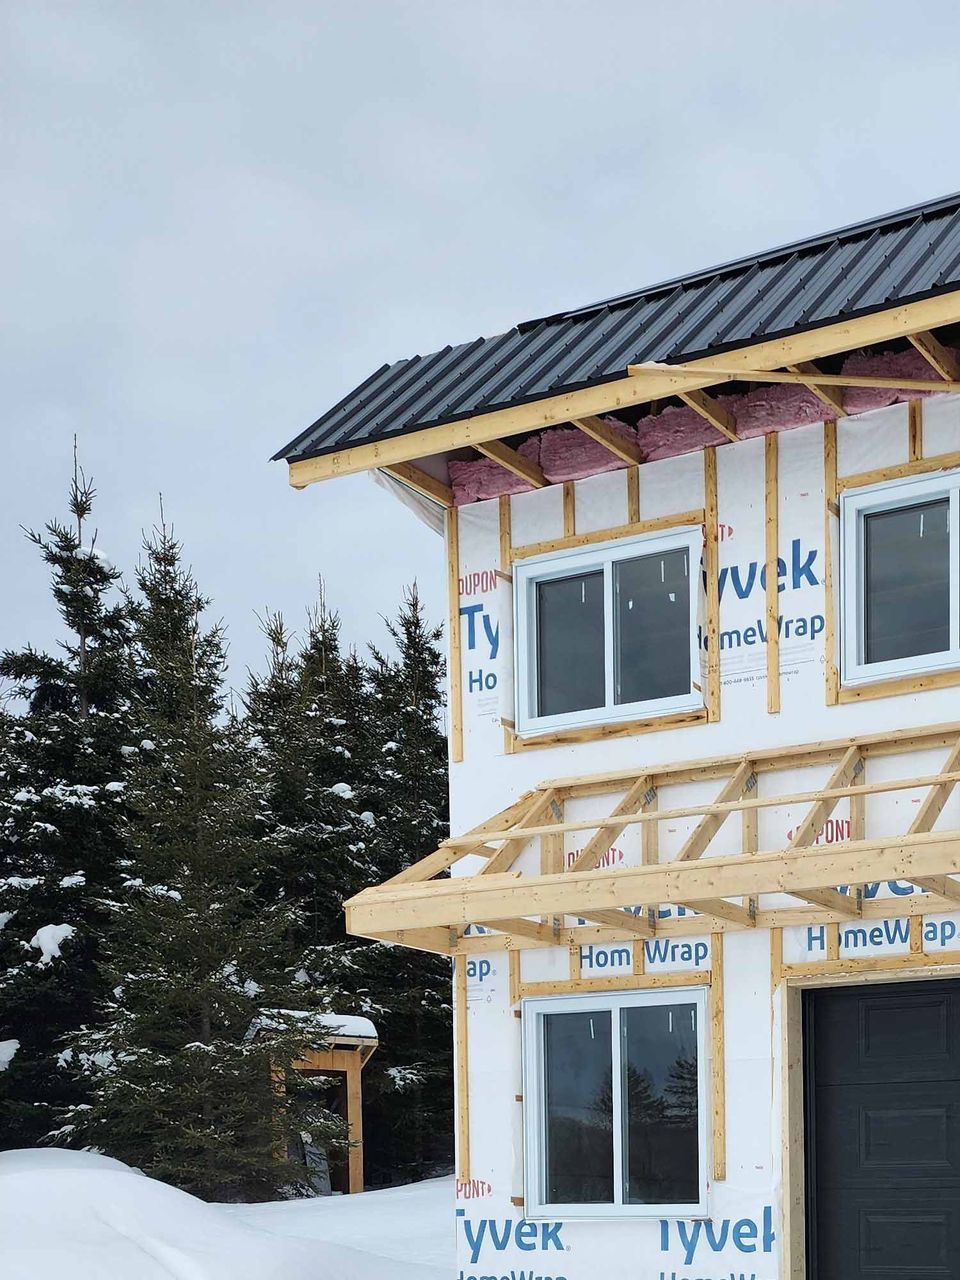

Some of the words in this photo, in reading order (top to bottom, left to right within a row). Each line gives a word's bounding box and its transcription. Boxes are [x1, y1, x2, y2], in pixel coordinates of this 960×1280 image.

[459, 569, 497, 596] DUPON
[807, 919, 957, 951] HmeWap
[580, 939, 708, 968] HomWrap
[456, 1179, 486, 1199] PONT
[456, 1209, 565, 1264] yvek
